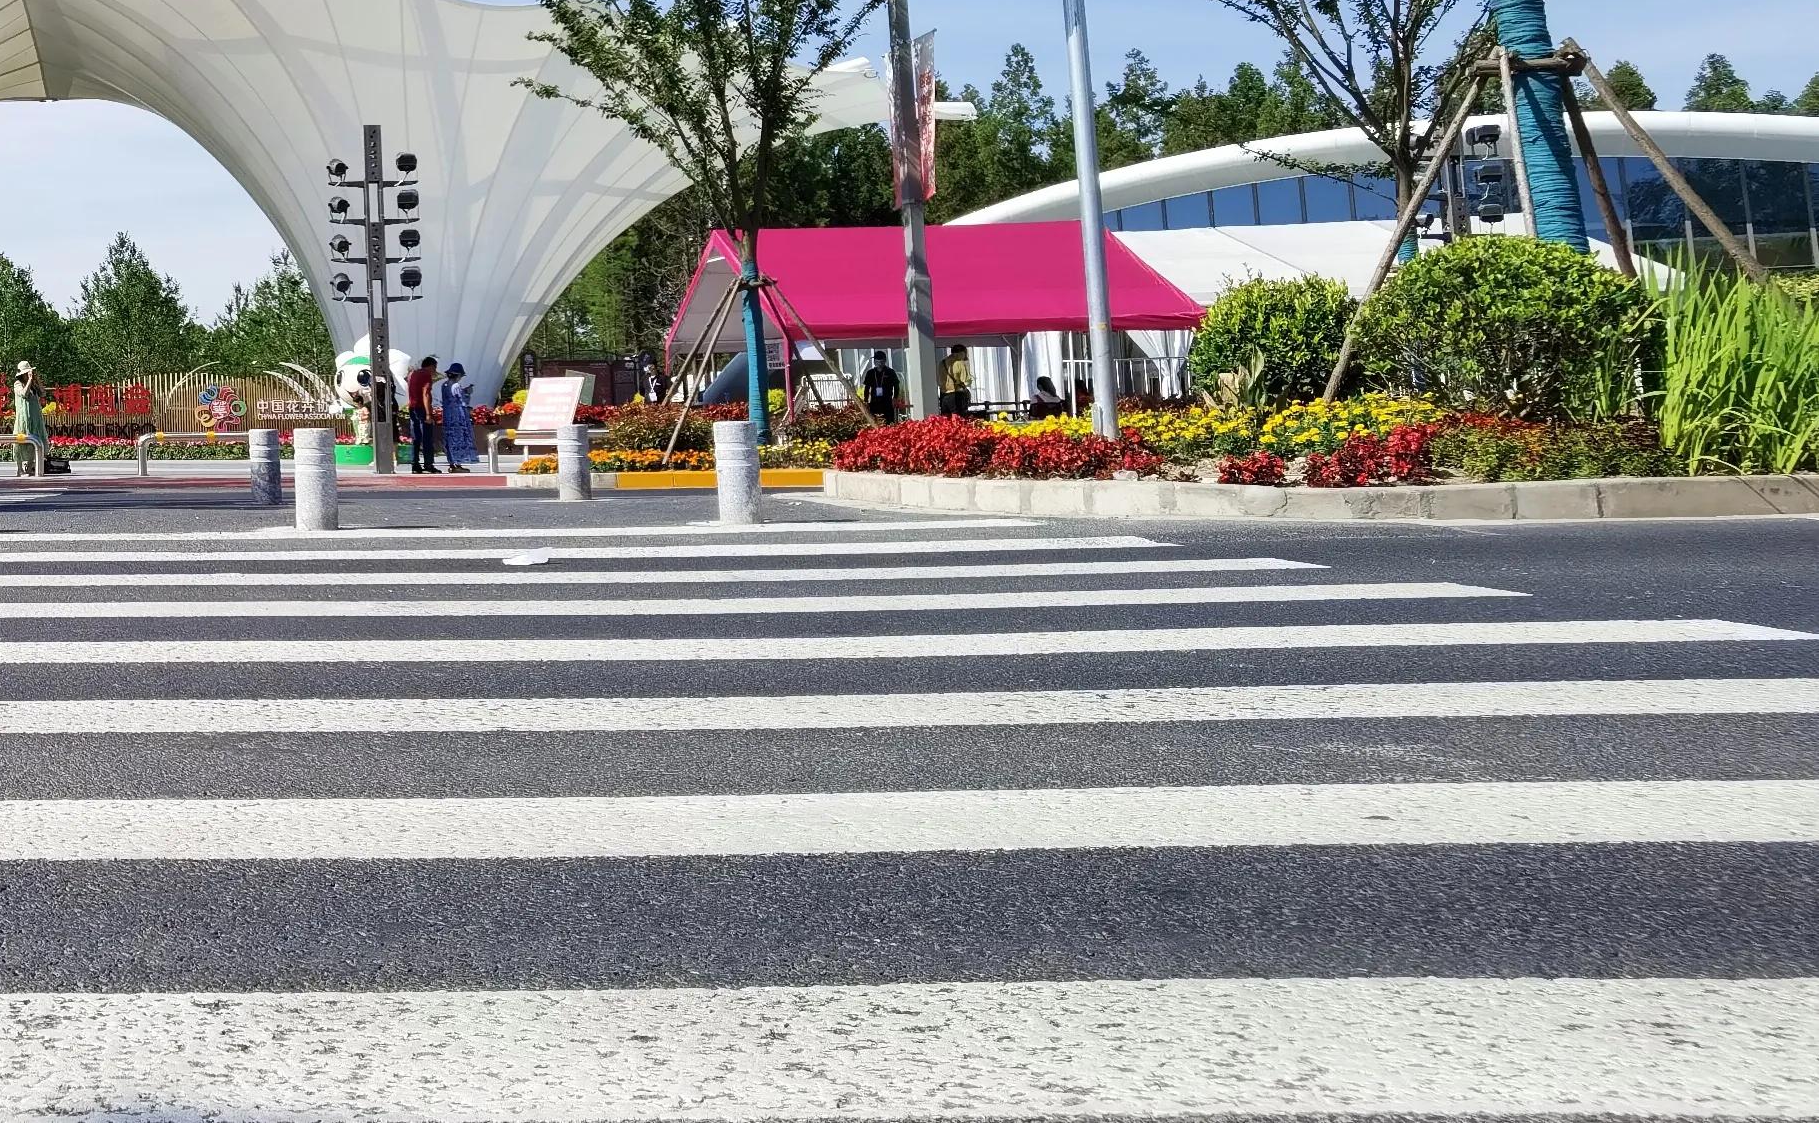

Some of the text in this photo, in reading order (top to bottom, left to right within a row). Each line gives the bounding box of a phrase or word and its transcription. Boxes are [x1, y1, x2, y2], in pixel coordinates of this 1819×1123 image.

[256, 399, 330, 413] 中国花卉协
